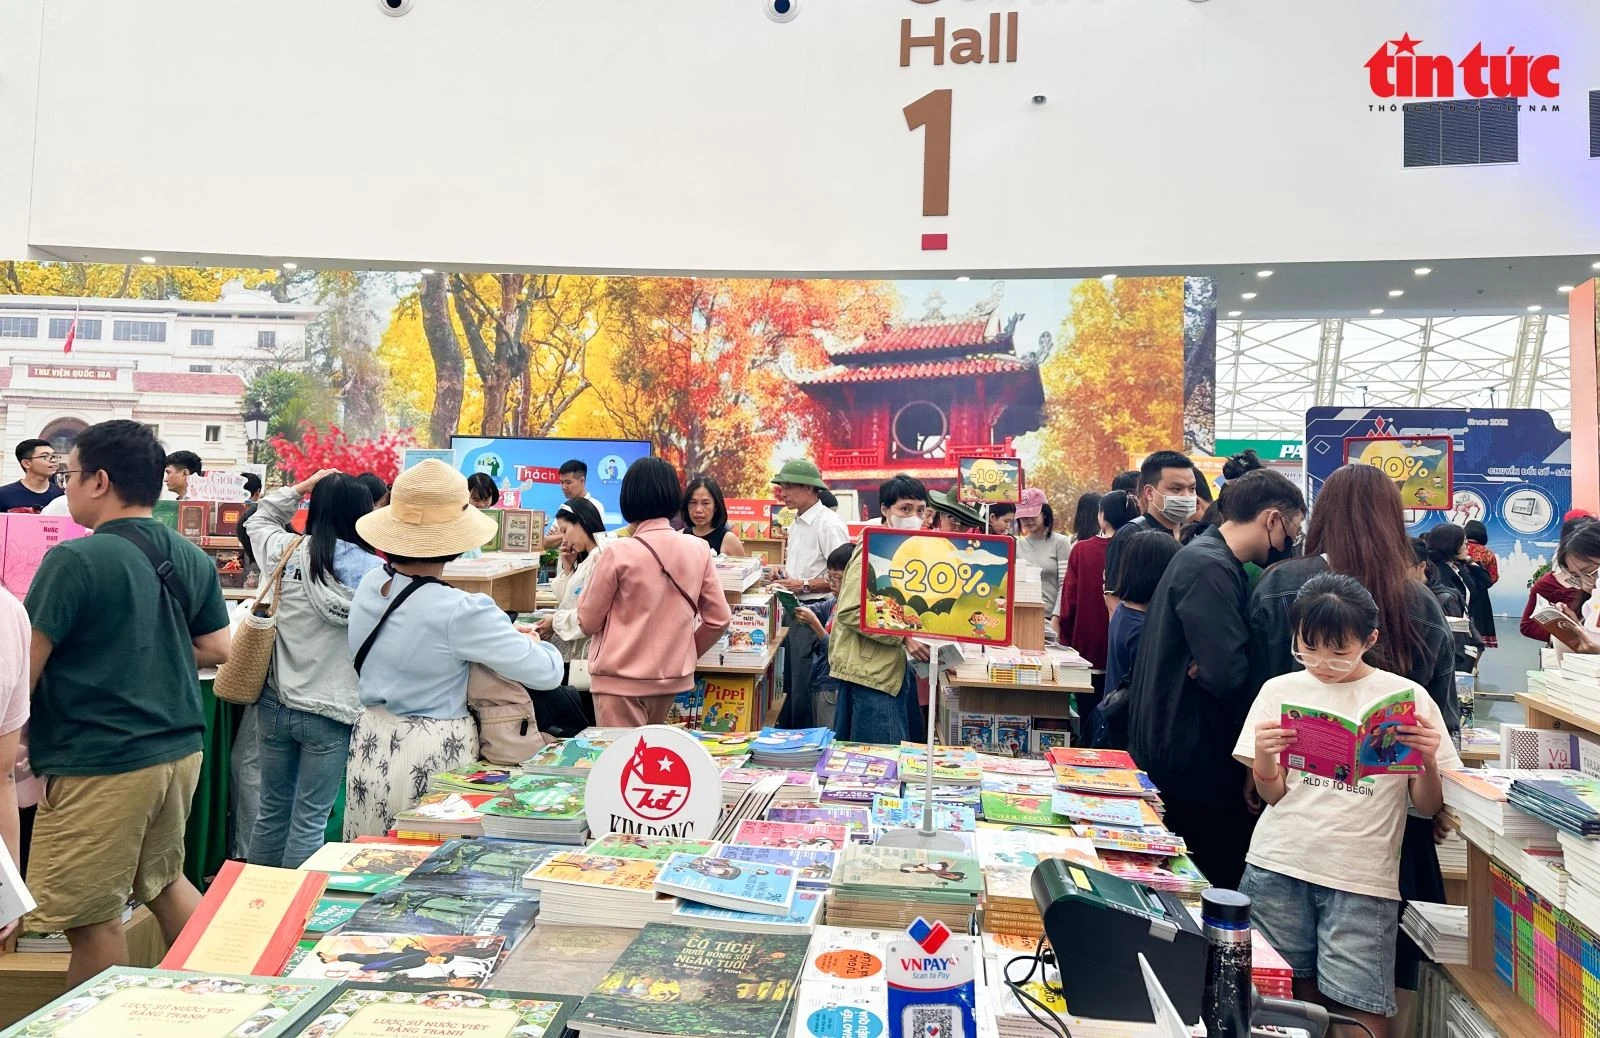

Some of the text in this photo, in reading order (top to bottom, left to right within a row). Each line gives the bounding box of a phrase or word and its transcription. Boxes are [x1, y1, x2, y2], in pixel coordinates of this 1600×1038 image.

[900, 12, 1018, 67] Hall
[902, 89, 952, 217] 1
[97, 370, 112, 378] GIA
[1467, 418, 1489, 426] Since
[513, 464, 556, 481] Thách
[970, 468, 1011, 484] -10%
[889, 559, 991, 597] -20%
[704, 682, 745, 701] Pippi
[1300, 776, 1374, 797] RLD IS TO BEGIN
[714, 940, 755, 954] TÍCH
[912, 972, 928, 980] Scan
[937, 972, 950, 981] Pay
[423, 1028, 465, 1036] TRANH
